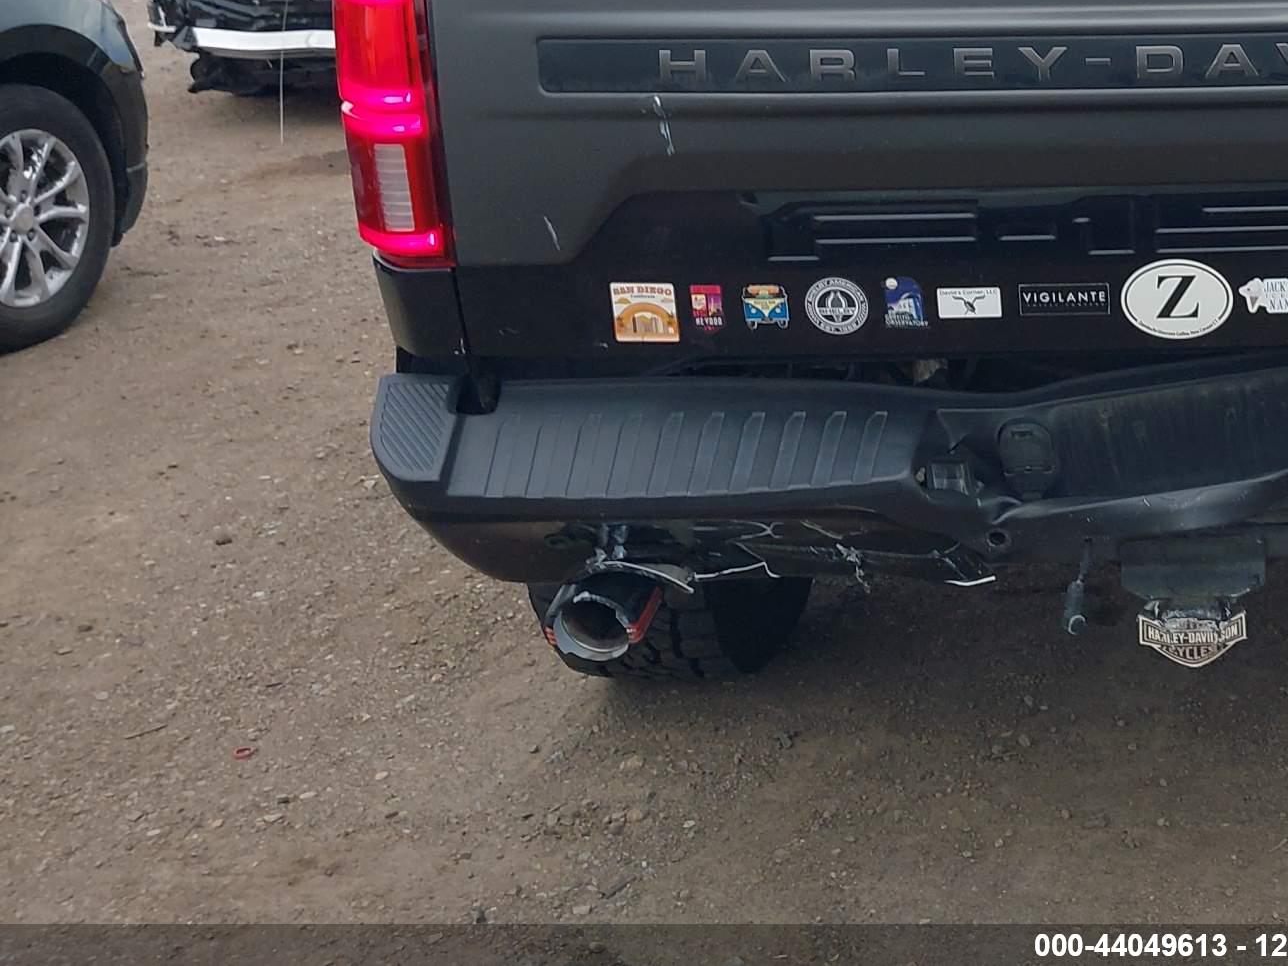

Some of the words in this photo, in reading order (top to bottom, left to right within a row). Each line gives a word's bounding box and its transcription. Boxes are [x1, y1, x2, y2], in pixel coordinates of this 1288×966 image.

[613, 286, 635, 295] SAN
[637, 286, 673, 296] DIEGO
[1264, 281, 1286, 292] JACK
[1022, 291, 1106, 303] VIGILANTE
[1156, 274, 1200, 319] Z
